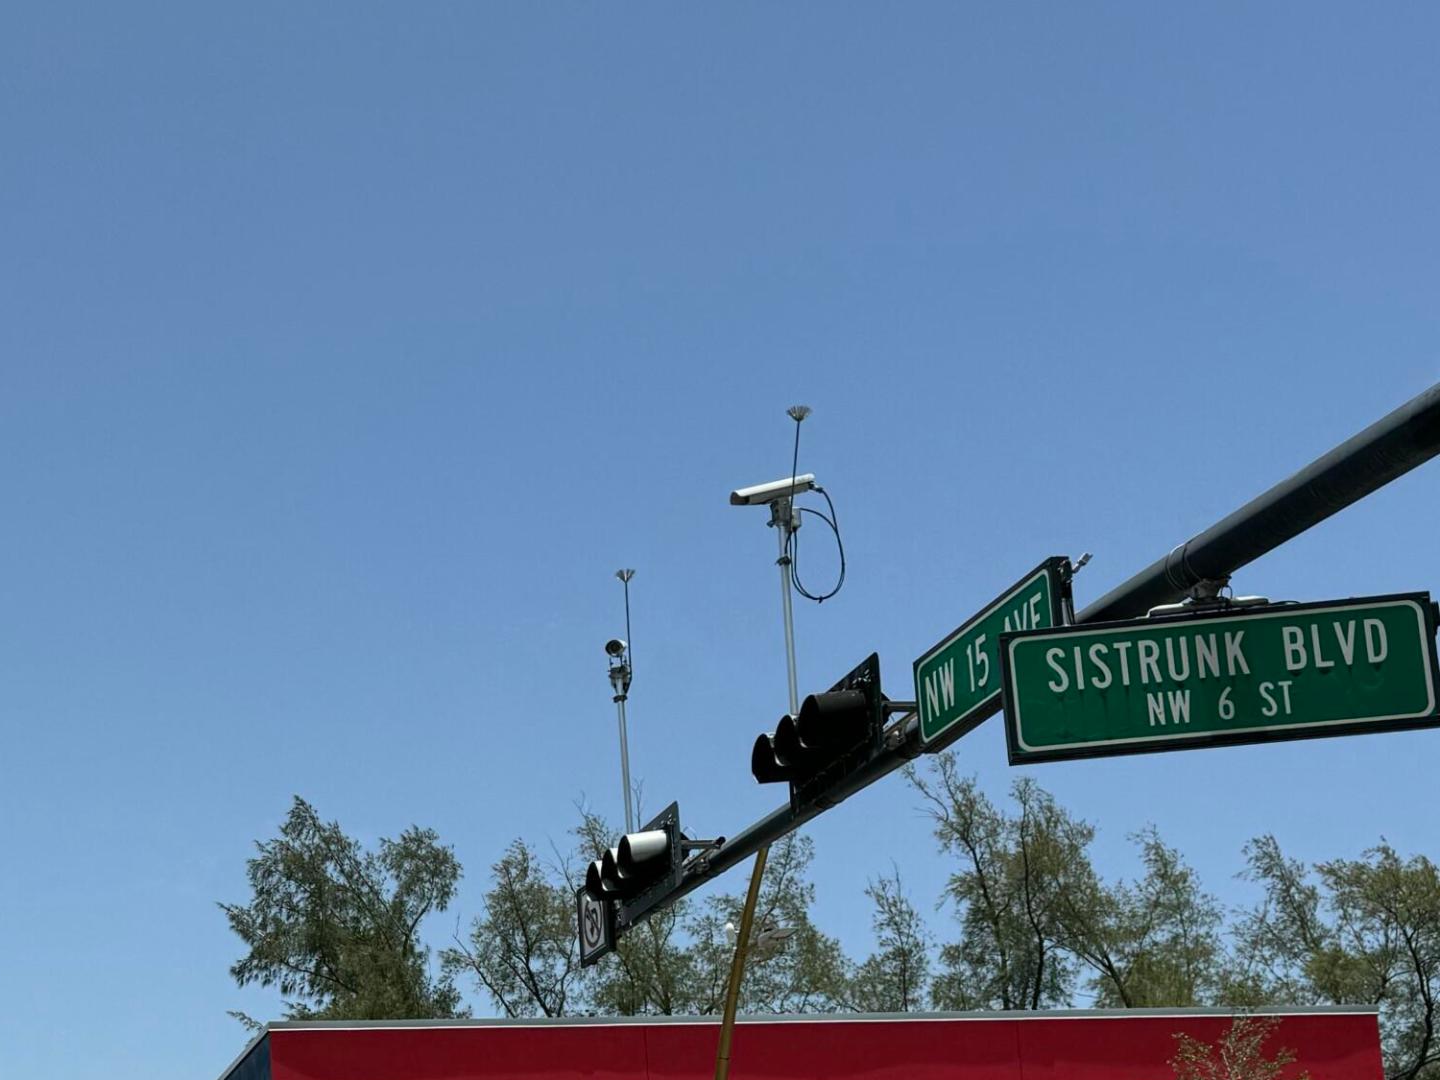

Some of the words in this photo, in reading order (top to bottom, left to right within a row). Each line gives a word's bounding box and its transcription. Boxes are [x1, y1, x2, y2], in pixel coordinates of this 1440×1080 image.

[924, 657, 955, 723] NW
[966, 633, 990, 692] 15
[1045, 630, 1251, 692] SISTRUNK
[1282, 618, 1388, 671] BLVD
[1146, 690, 1191, 726] NW
[1218, 686, 1236, 720] 6
[1259, 680, 1293, 717] ST
